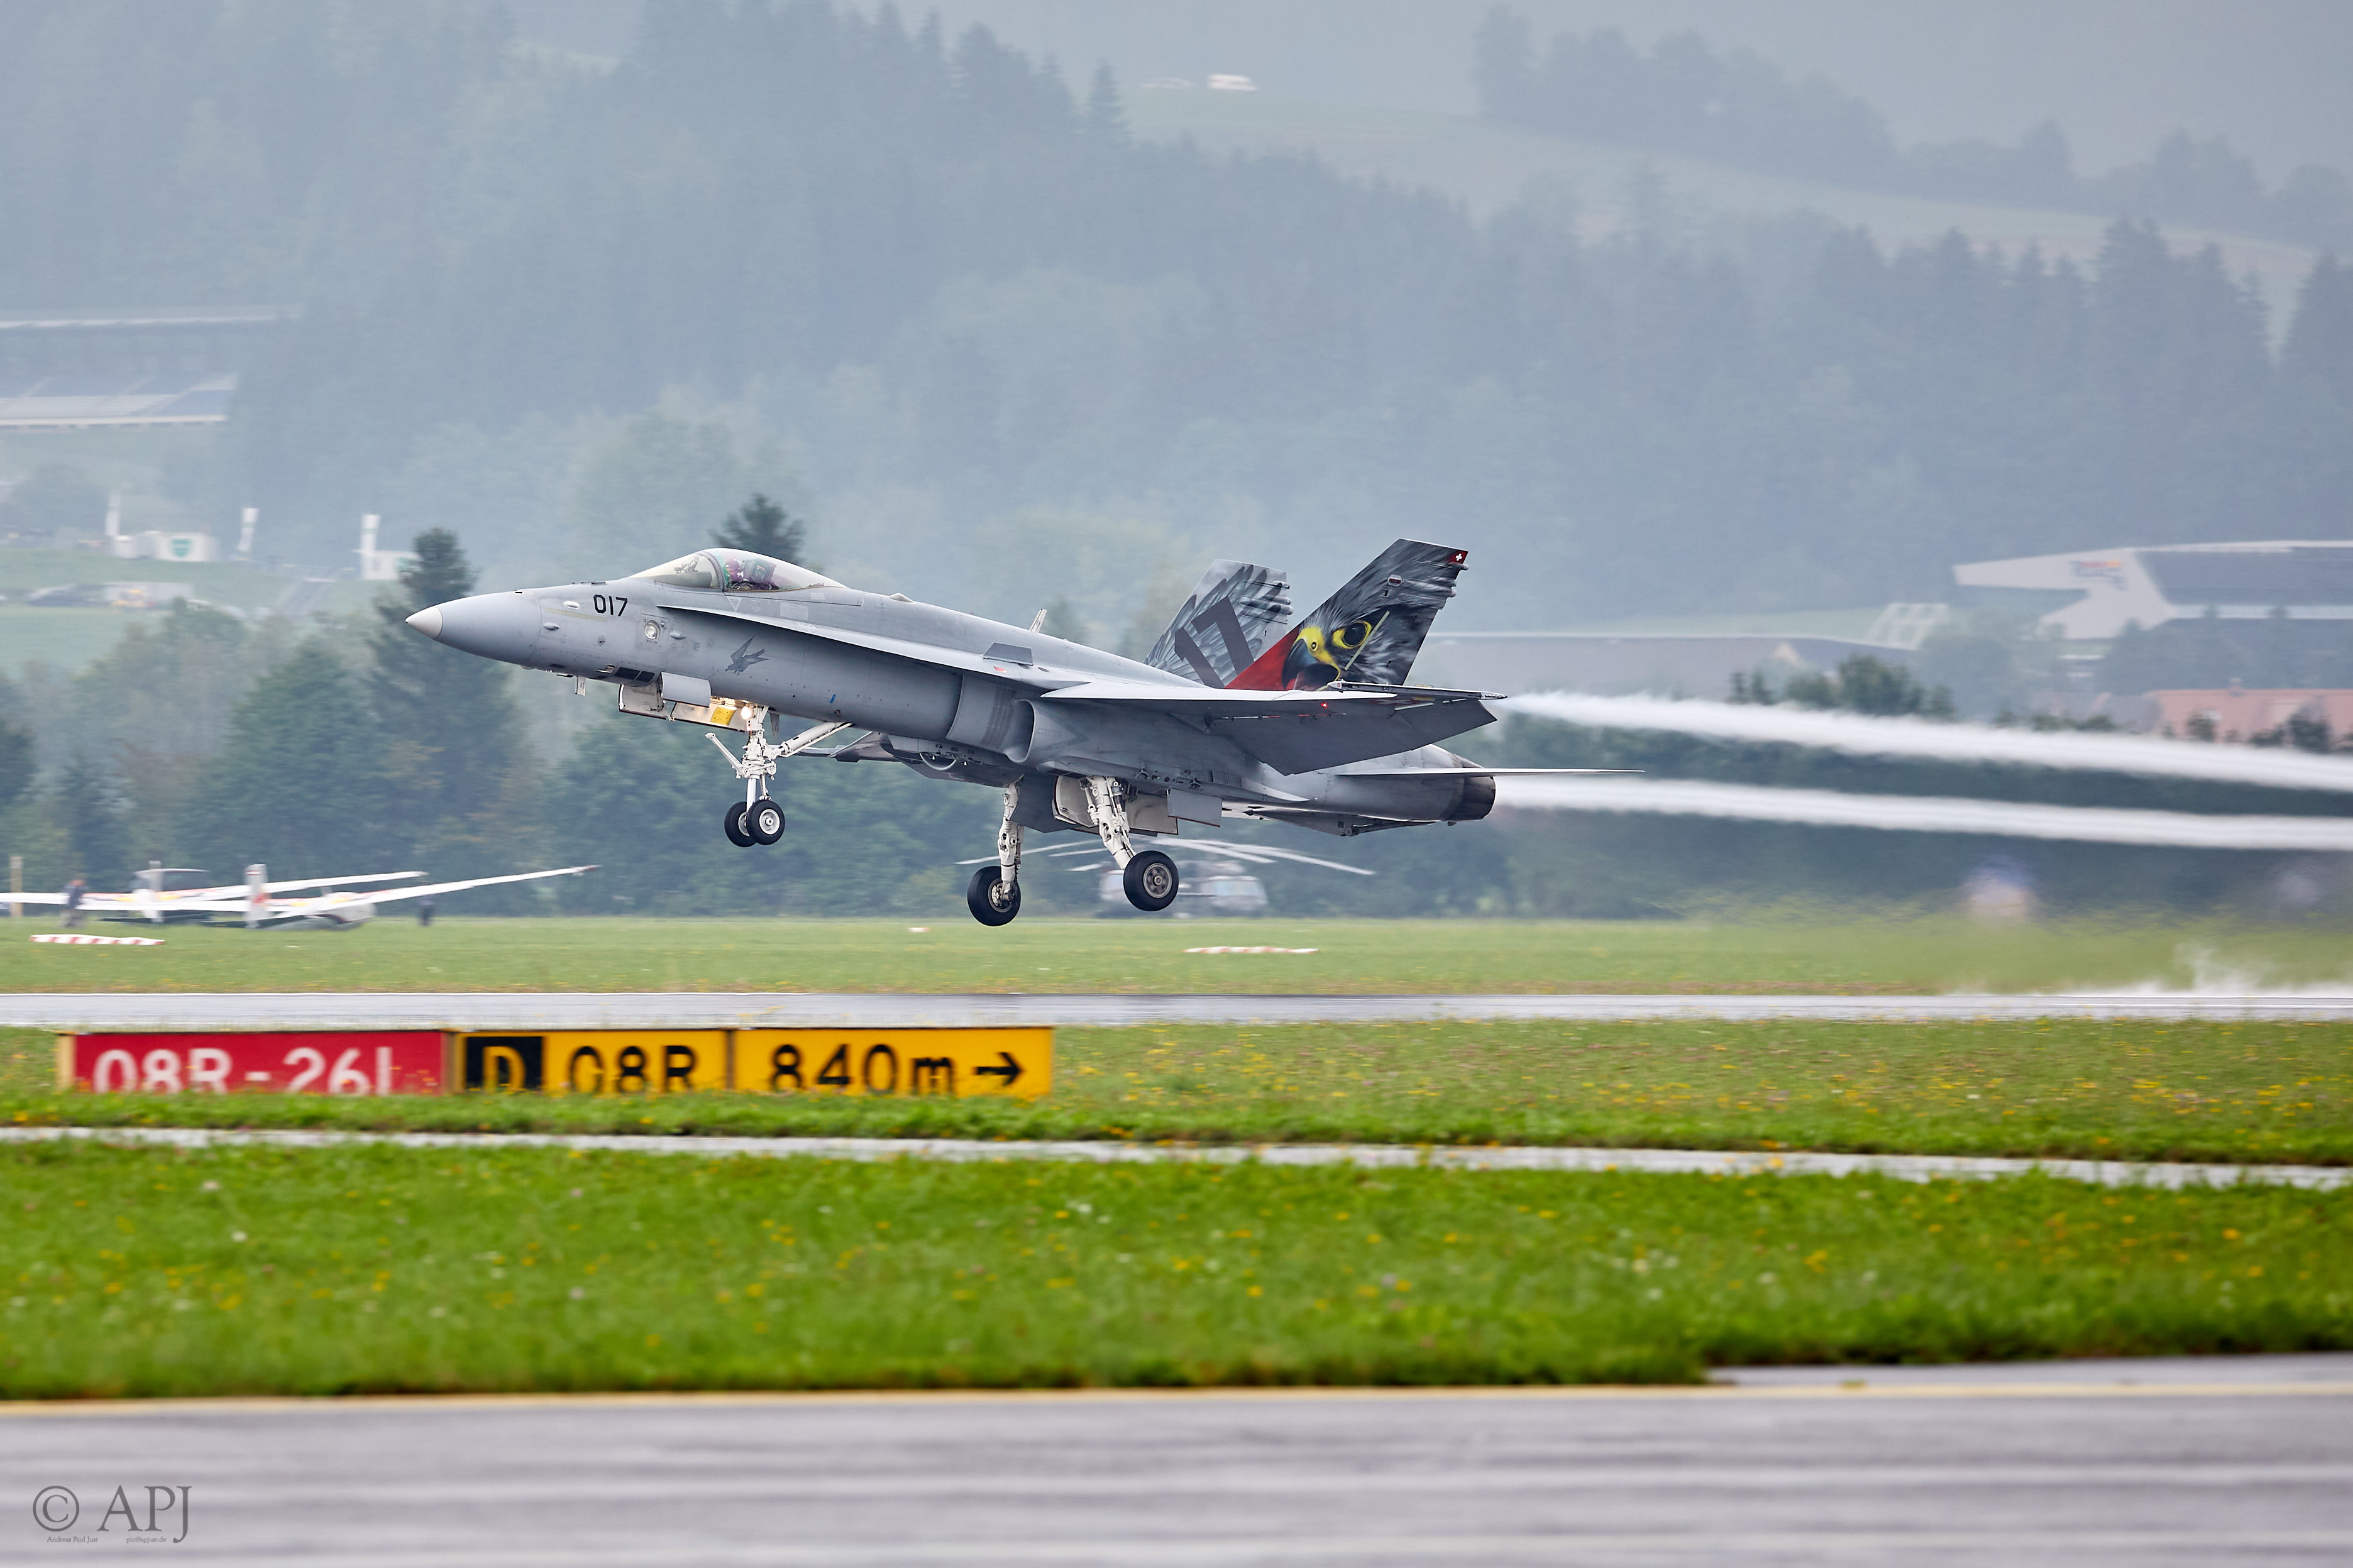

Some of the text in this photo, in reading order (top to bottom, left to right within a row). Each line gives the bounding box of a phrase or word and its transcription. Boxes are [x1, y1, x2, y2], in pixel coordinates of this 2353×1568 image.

[593, 594, 628, 617] 017
[1174, 596, 1255, 689] 17
[482, 1043, 957, 1095] D 08R 840m
